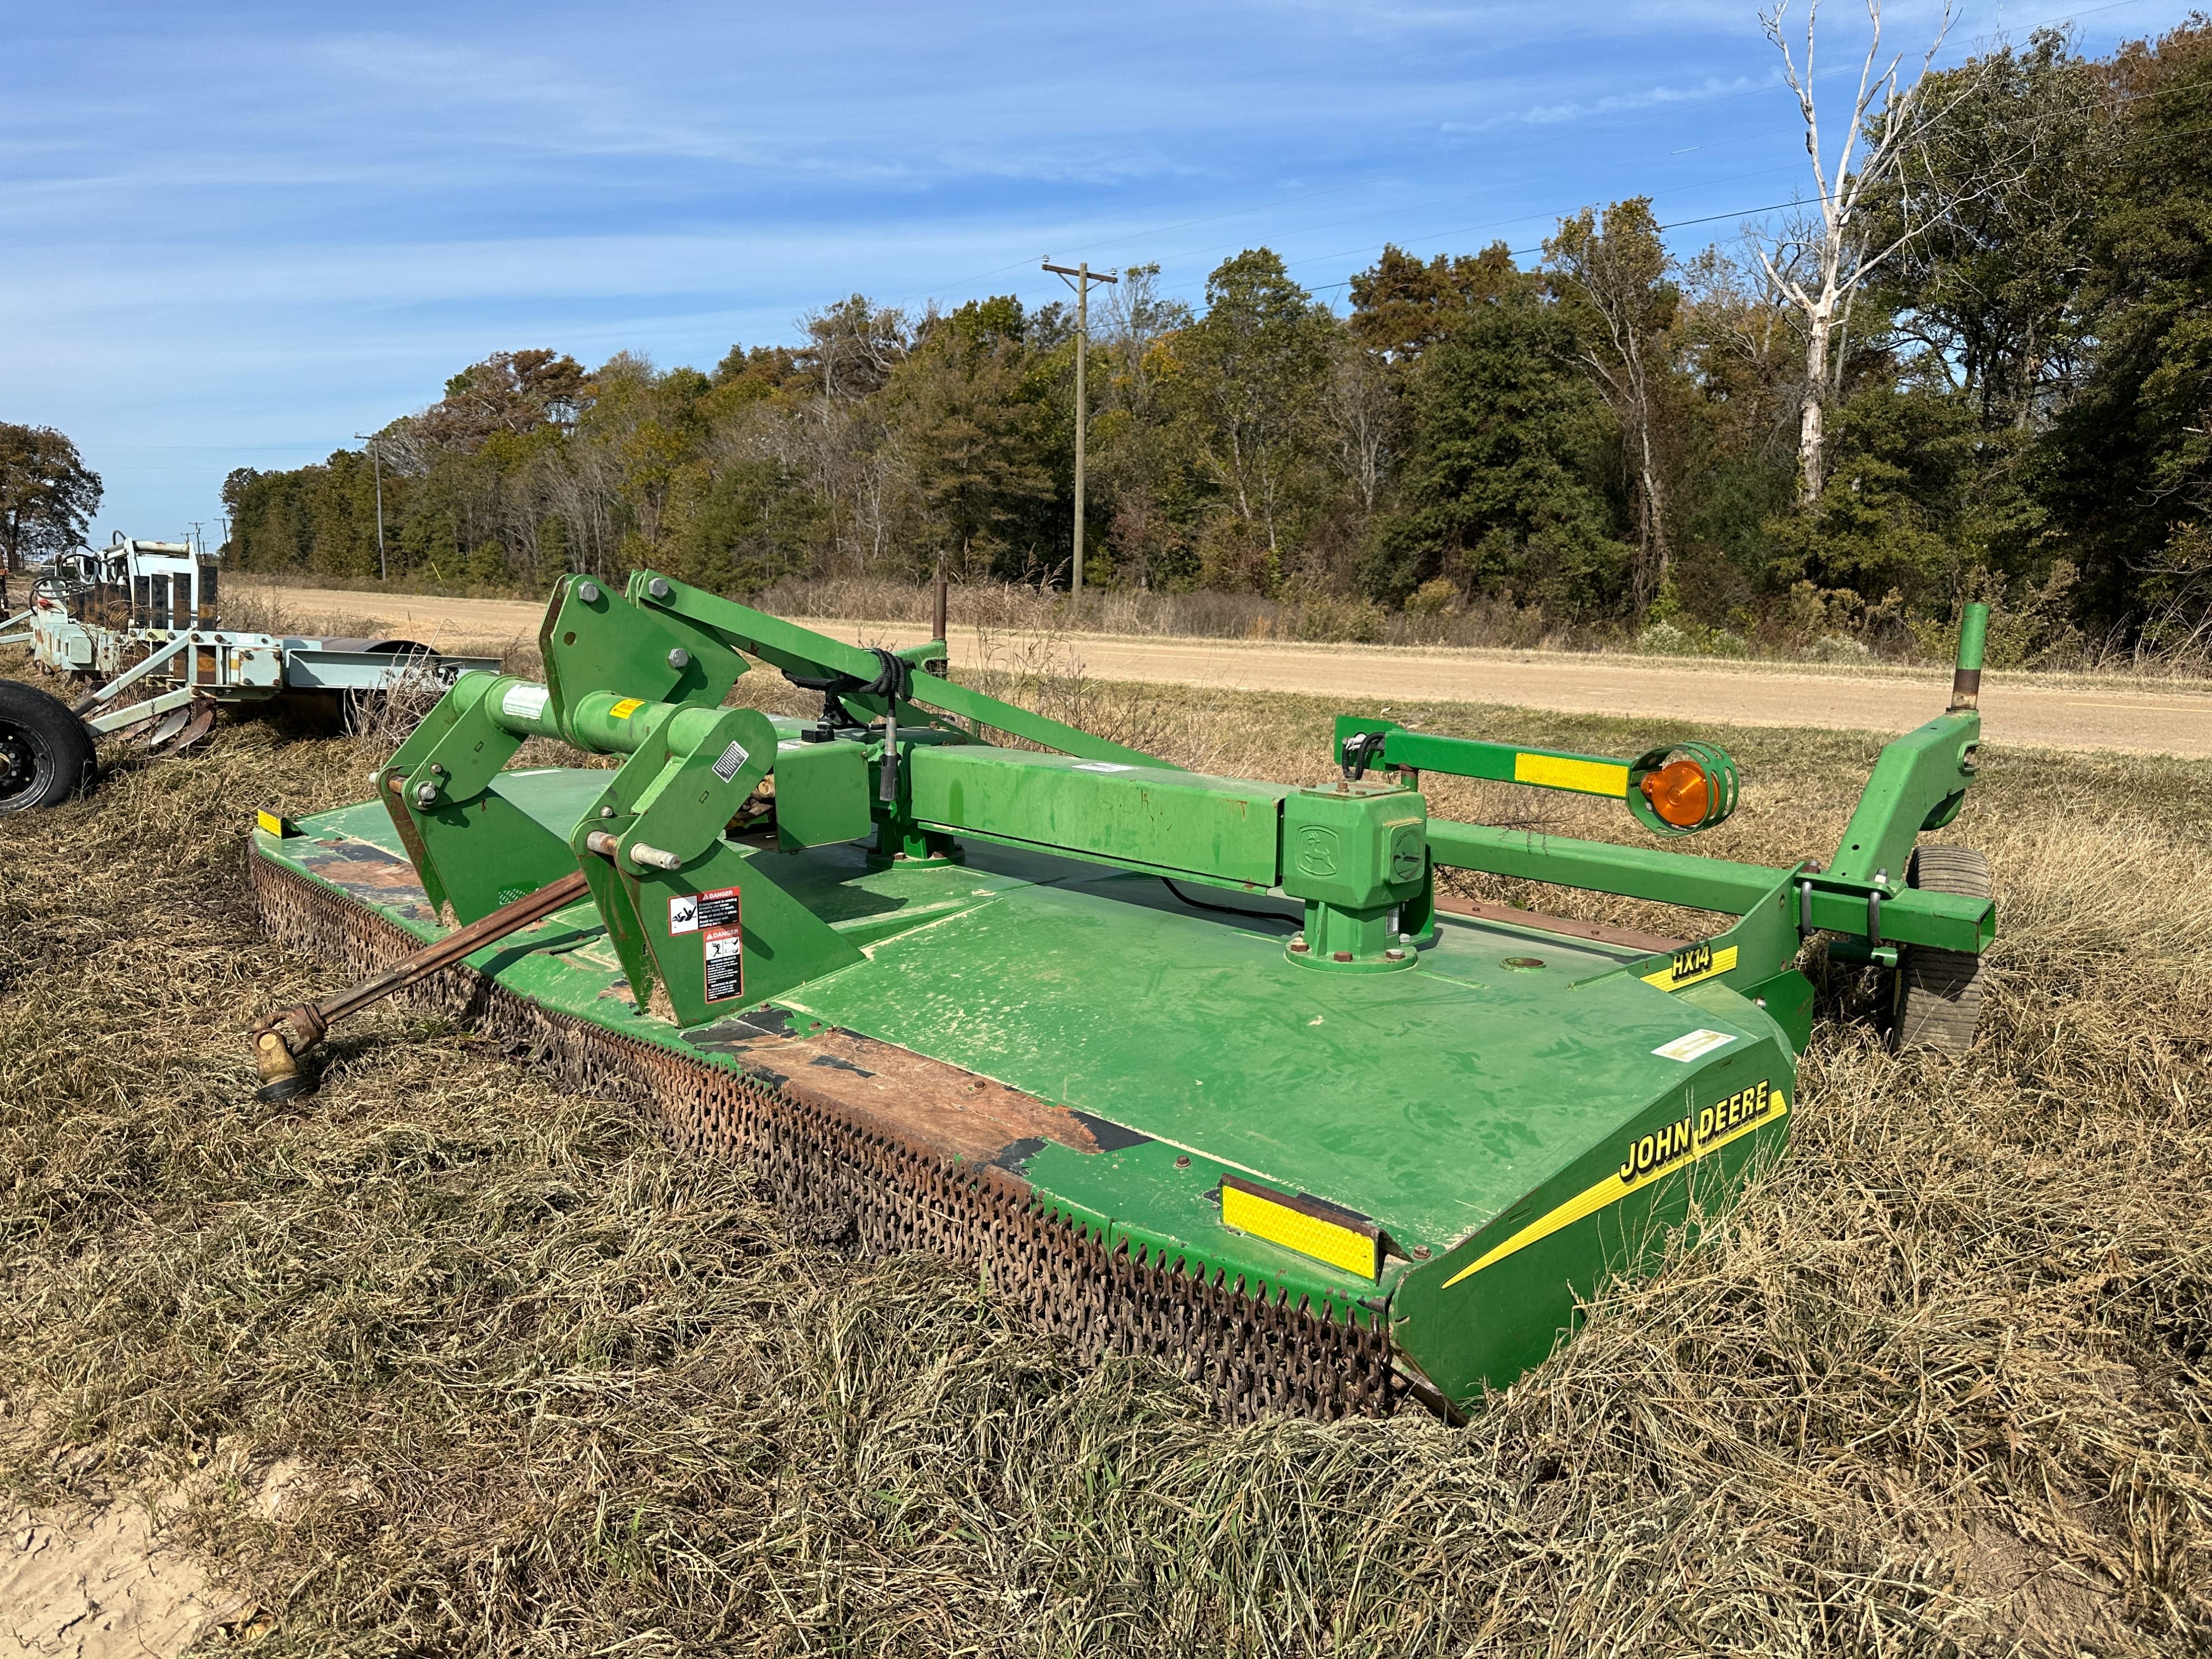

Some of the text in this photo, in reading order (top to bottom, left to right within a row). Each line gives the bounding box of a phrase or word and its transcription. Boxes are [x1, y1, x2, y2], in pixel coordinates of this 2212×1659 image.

[709, 890, 733, 899] DANGER
[713, 929, 738, 938] DANGER
[1672, 945, 1710, 980] HX14
[1620, 1079, 1769, 1181] JOHN DEERE
